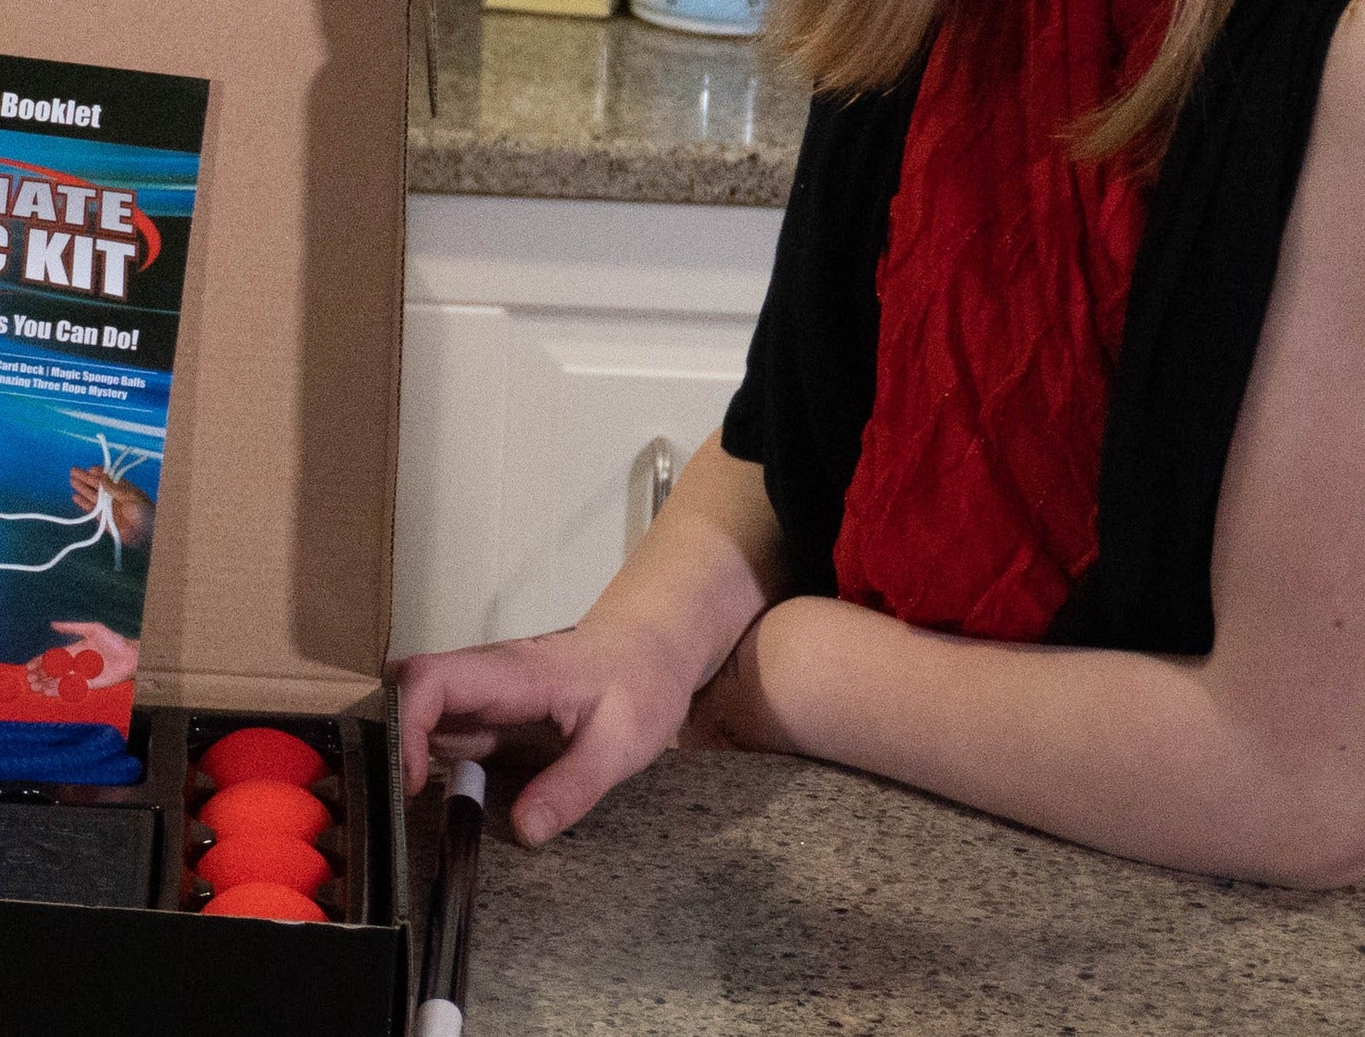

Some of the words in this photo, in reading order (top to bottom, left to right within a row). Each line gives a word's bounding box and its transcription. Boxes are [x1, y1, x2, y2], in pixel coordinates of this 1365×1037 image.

[1, 95, 103, 129] Booklet
[24, 227, 137, 298] KIT
[13, 315, 52, 340] You
[56, 321, 99, 346] Can
[102, 326, 139, 351] Do!
[20, 362, 44, 377] Deck
[51, 365, 81, 381] Magic
[82, 370, 120, 387] Sponge
[121, 375, 147, 389] Balls
[32, 378, 62, 393] Three
[62, 382, 88, 397] Rope
[87, 385, 129, 401] Mystery
